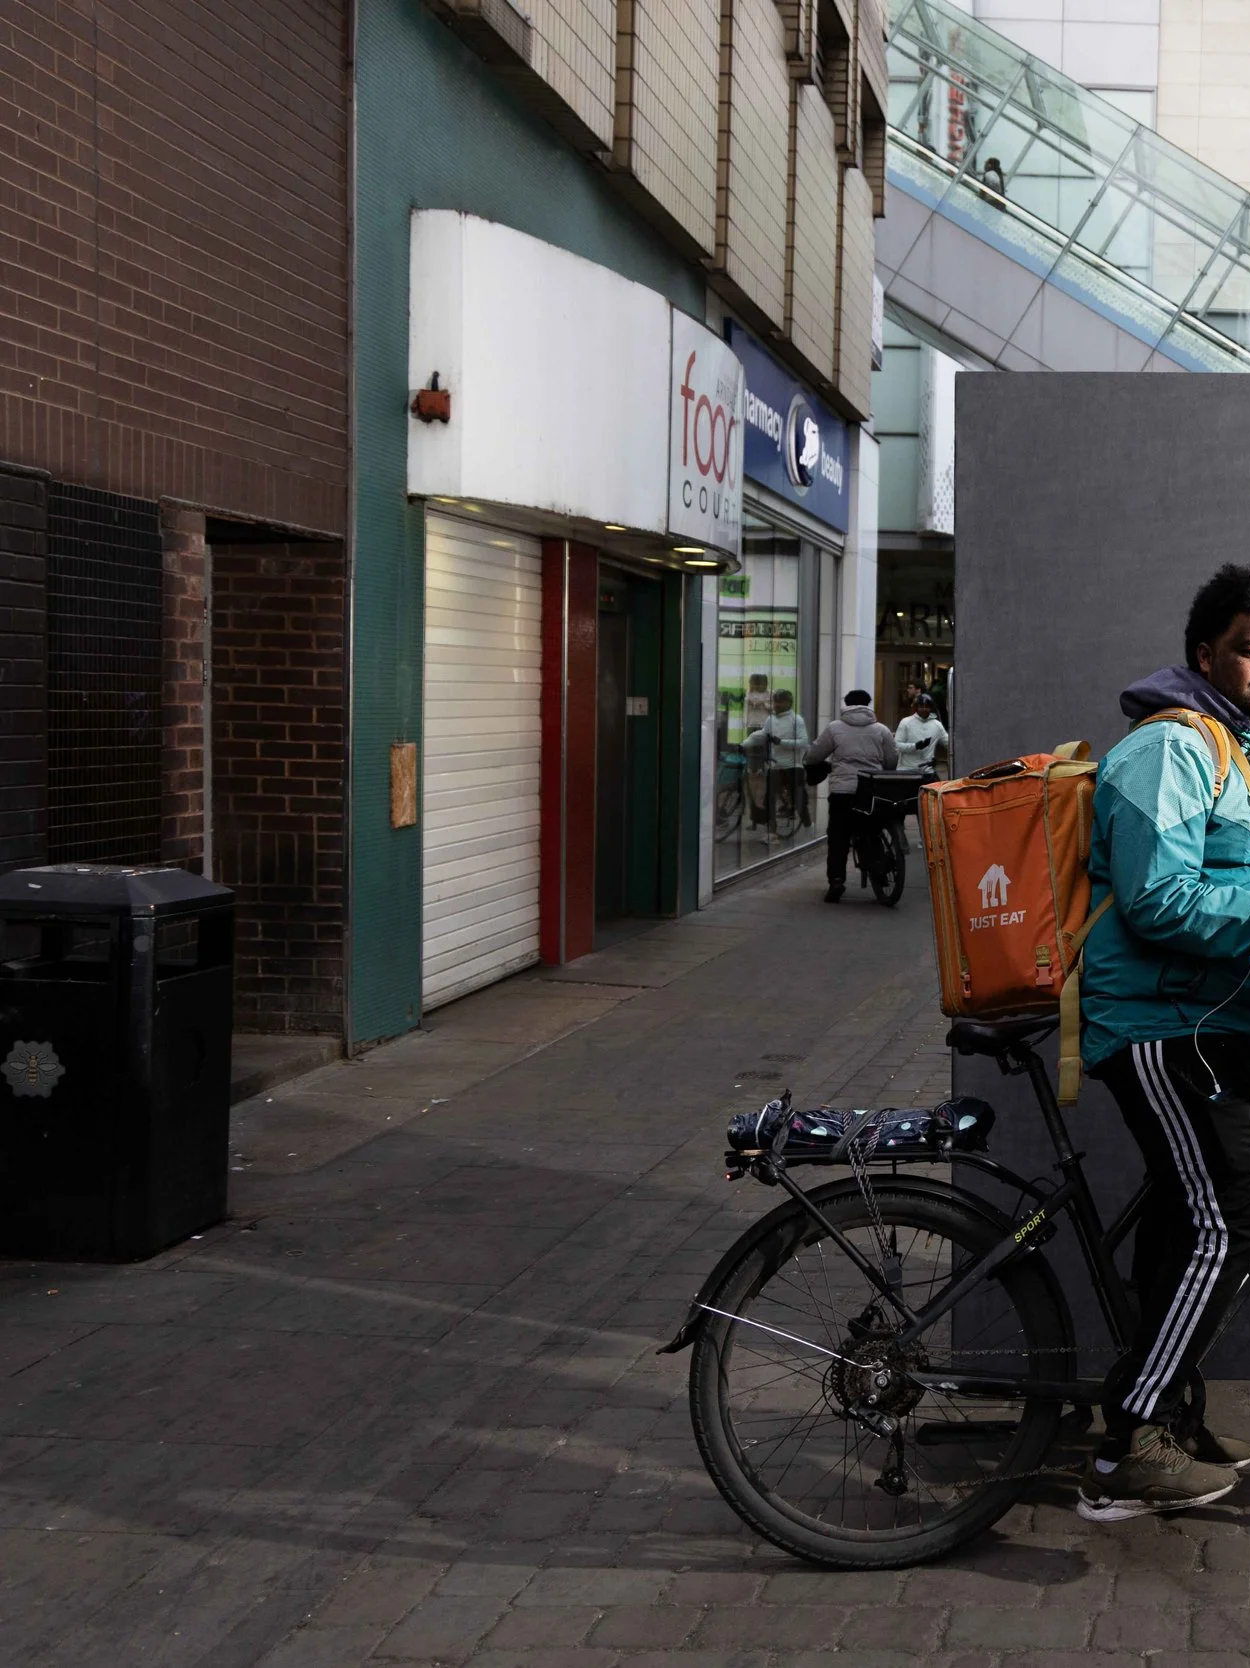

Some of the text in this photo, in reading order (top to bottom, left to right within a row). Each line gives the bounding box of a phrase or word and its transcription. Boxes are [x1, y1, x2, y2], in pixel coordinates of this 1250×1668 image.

[821, 441, 844, 496] beauty
[969, 909, 1027, 932] JUST EAT
[1014, 1209, 1046, 1243] SPORT
